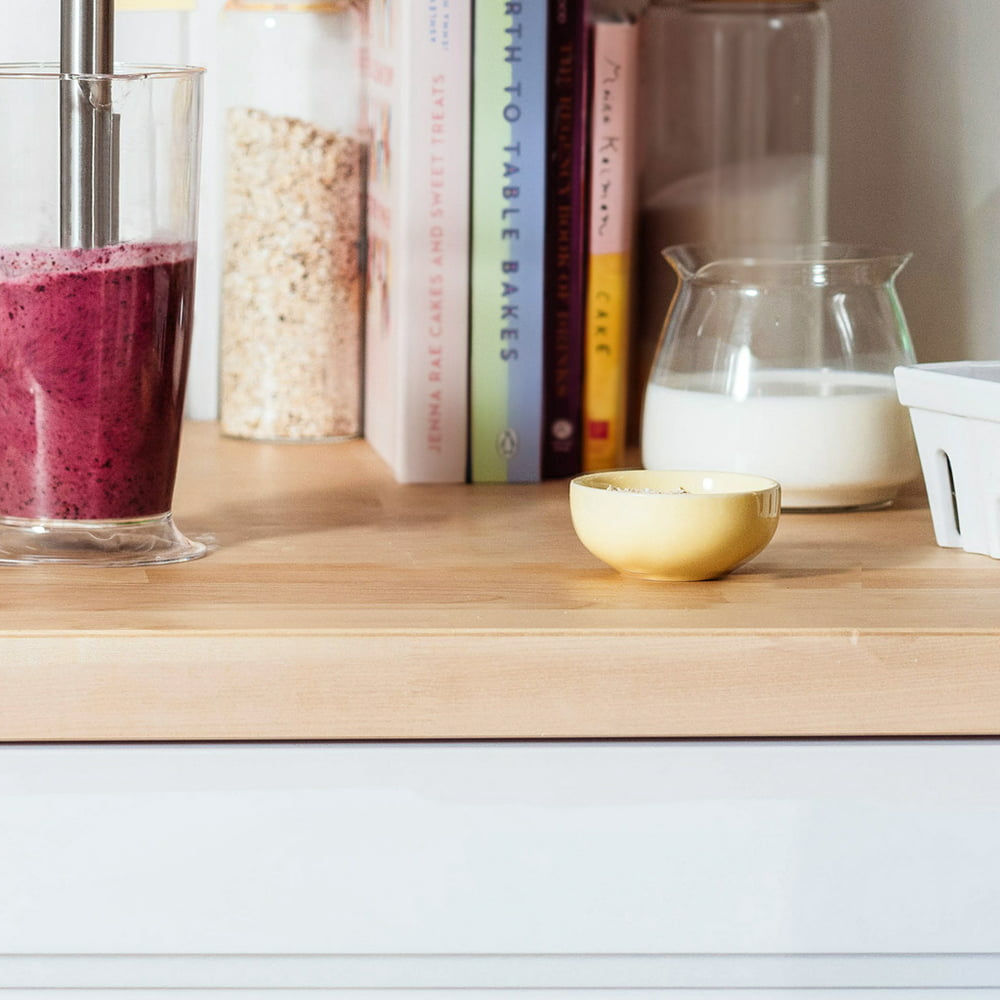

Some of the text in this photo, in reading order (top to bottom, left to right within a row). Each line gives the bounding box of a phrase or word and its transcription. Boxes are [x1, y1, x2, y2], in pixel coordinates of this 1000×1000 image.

[502, 82, 522, 124] TO
[558, 43, 572, 85] THE
[557, 96, 572, 196] REGENCY
[500, 141, 521, 242] TABLE
[426, 73, 445, 454] JENNA RAE CAKES AND SWEET TREATS
[556, 204, 571, 269] BOOK
[499, 260, 520, 363] BAKES
[555, 310, 570, 398] DRINKS
[594, 290, 611, 356] CAKE
